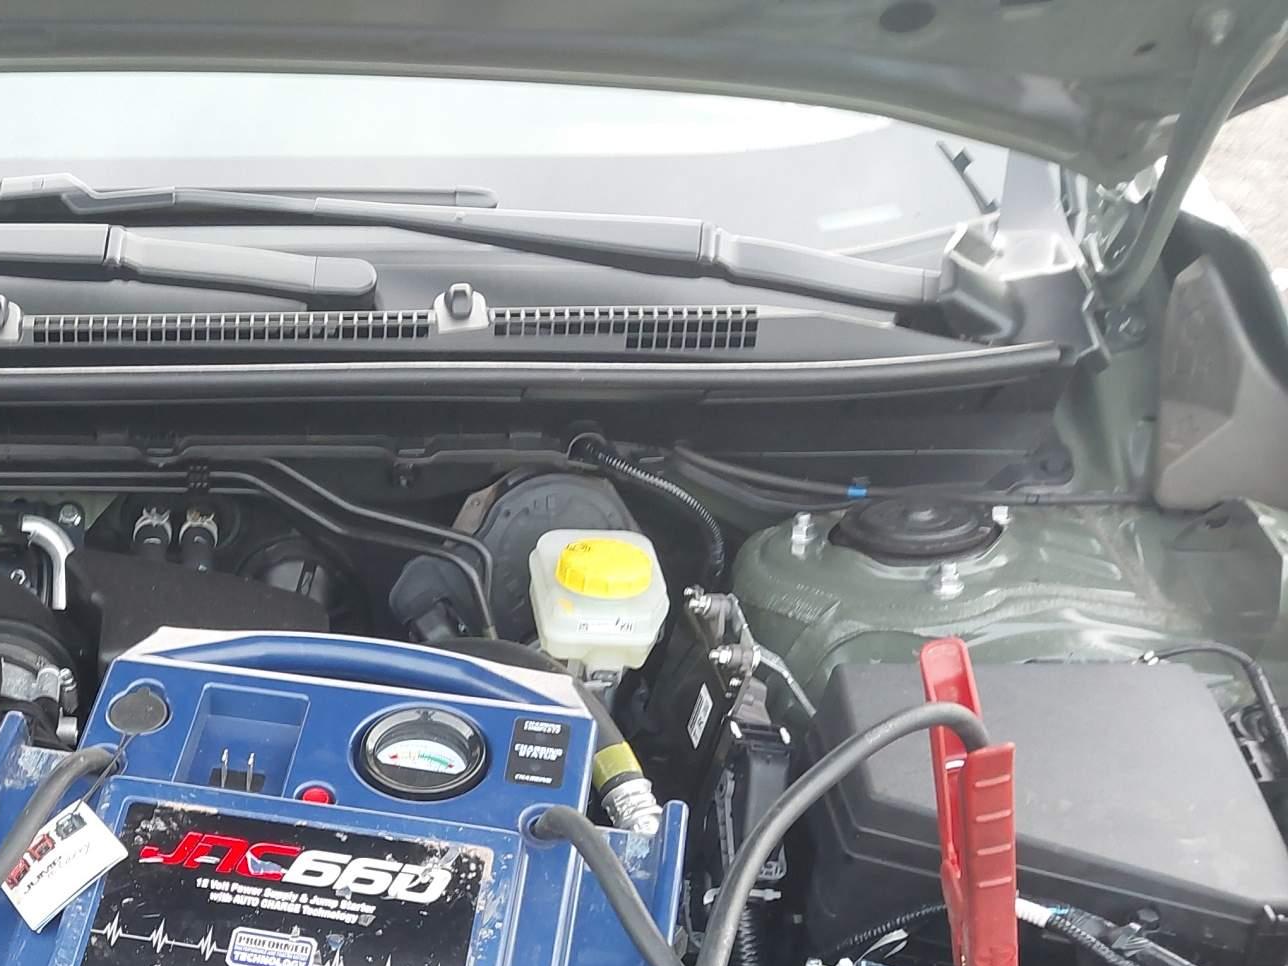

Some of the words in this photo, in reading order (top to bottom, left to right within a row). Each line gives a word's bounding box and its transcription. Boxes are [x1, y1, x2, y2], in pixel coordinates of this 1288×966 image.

[209, 892, 232, 904] with
[232, 894, 260, 908] AUTO
[260, 898, 302, 914] CHARGE
[302, 904, 360, 925] Technology
[210, 879, 230, 892] Volt
[230, 882, 263, 896] Power
[263, 887, 299, 902] Supply
[298, 893, 309, 904] &
[309, 894, 340, 909] Jump
[339, 898, 377, 914] Starter
